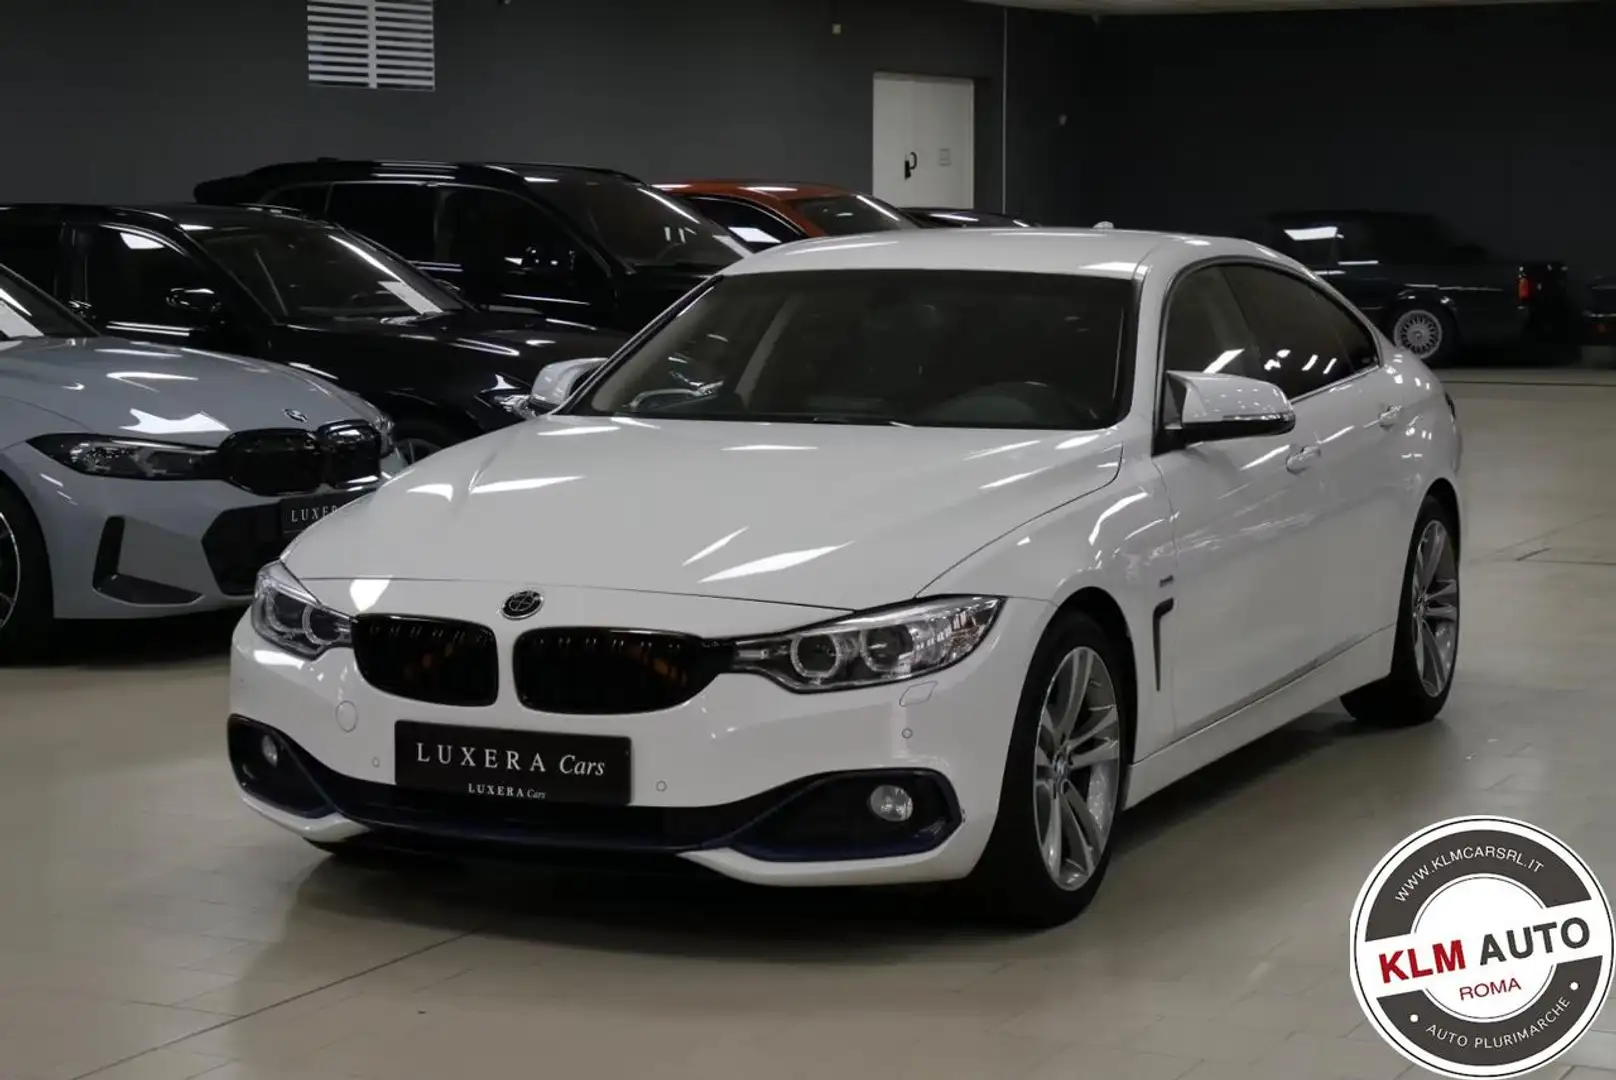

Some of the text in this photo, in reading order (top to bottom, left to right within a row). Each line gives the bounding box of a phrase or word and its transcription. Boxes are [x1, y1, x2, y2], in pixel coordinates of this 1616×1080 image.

[416, 743, 605, 776] LUXERA Cars
[468, 783, 546, 799] LUXERA Cars
